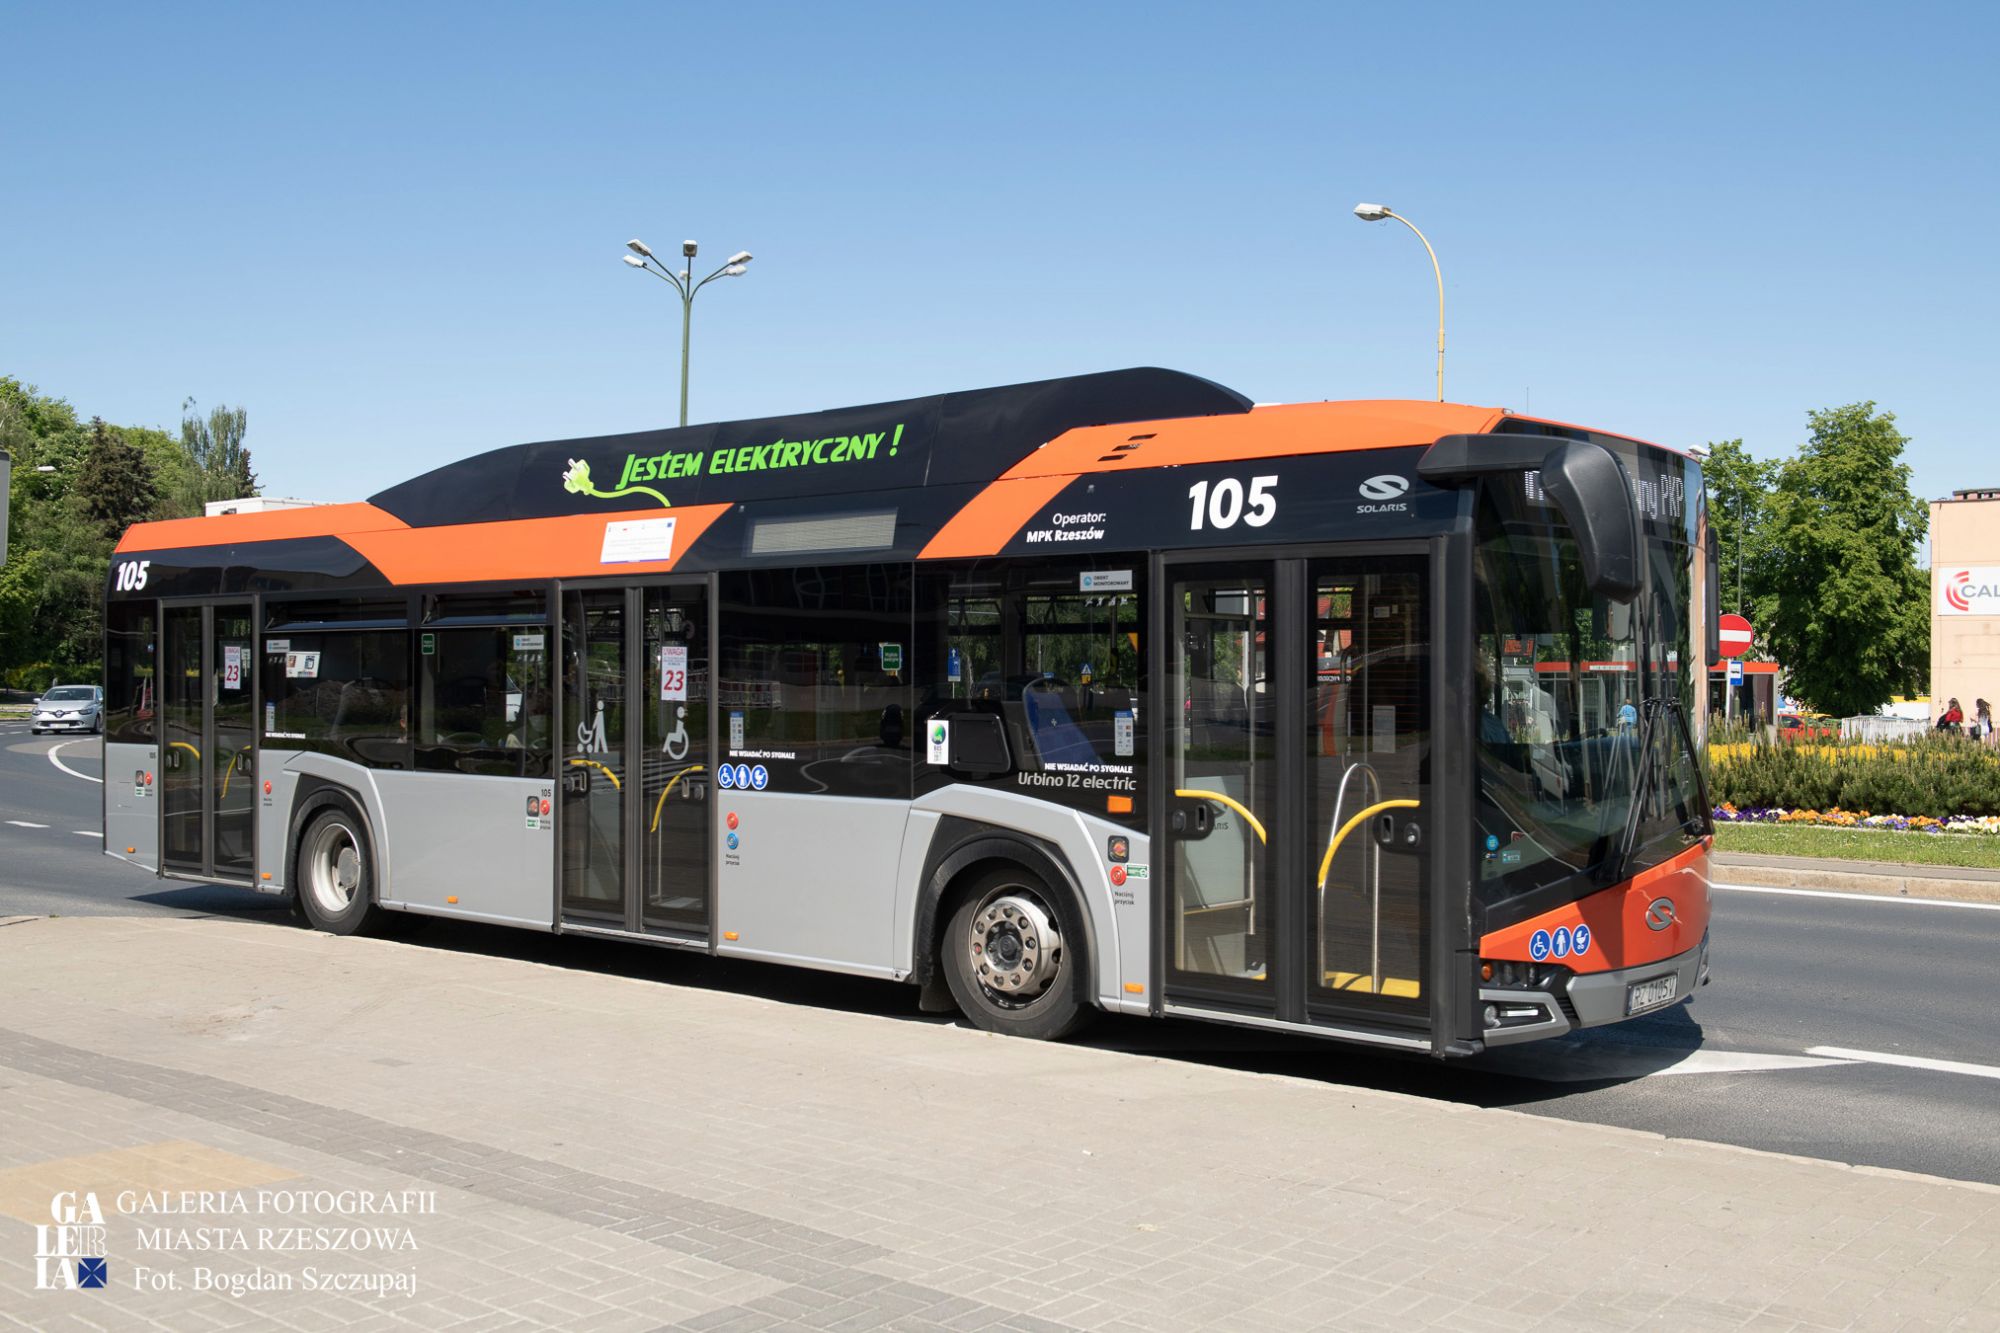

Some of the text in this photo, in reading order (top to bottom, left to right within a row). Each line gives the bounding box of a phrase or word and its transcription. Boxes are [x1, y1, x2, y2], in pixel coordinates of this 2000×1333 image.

[1188, 475, 1279, 531] 105
[1660, 473, 1684, 518] PKP
[1356, 502, 1407, 514] SOLARIS
[1052, 512, 1107, 528] Operator:
[1026, 526, 1105, 543] MPK Rzeszów
[116, 560, 151, 592] 105
[226, 664, 239, 682] 23
[663, 669, 685, 691] 23
[763, 751, 771, 759] PO
[1044, 762, 1134, 774] NIE WSIADAĆ PO SYGNALE
[1018, 772, 1137, 791] Urbino 12 electric
[541, 788, 552, 798] 105
[1632, 985, 1647, 1010] RZ
